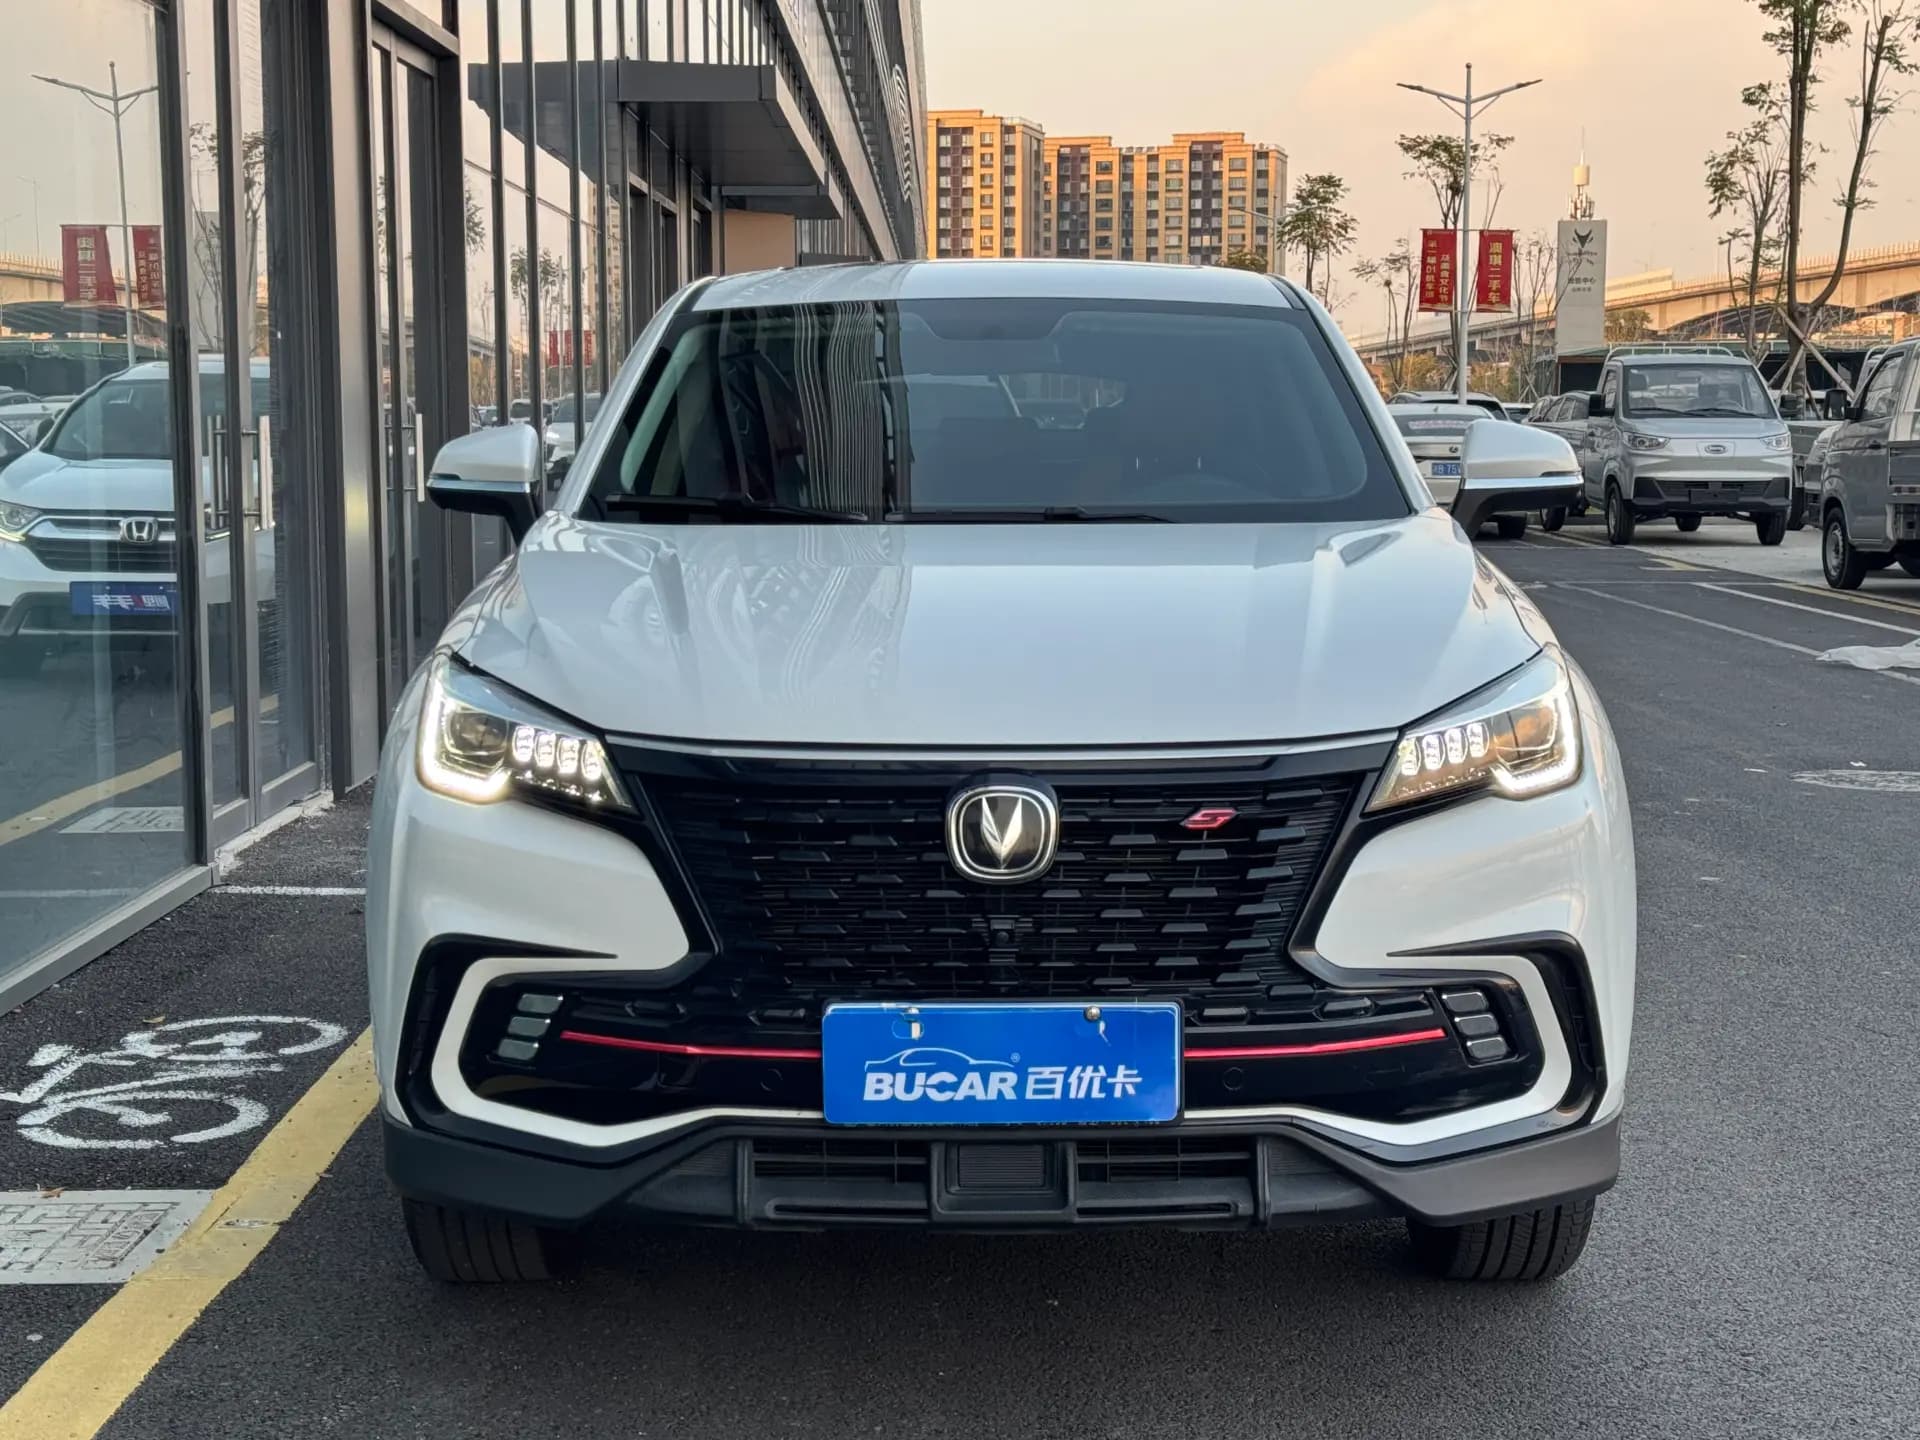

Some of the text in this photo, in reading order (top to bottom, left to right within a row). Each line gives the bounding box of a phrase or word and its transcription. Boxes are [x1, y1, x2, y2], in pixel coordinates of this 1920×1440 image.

[863, 1065, 1143, 1101] BUCAR 百优卡
